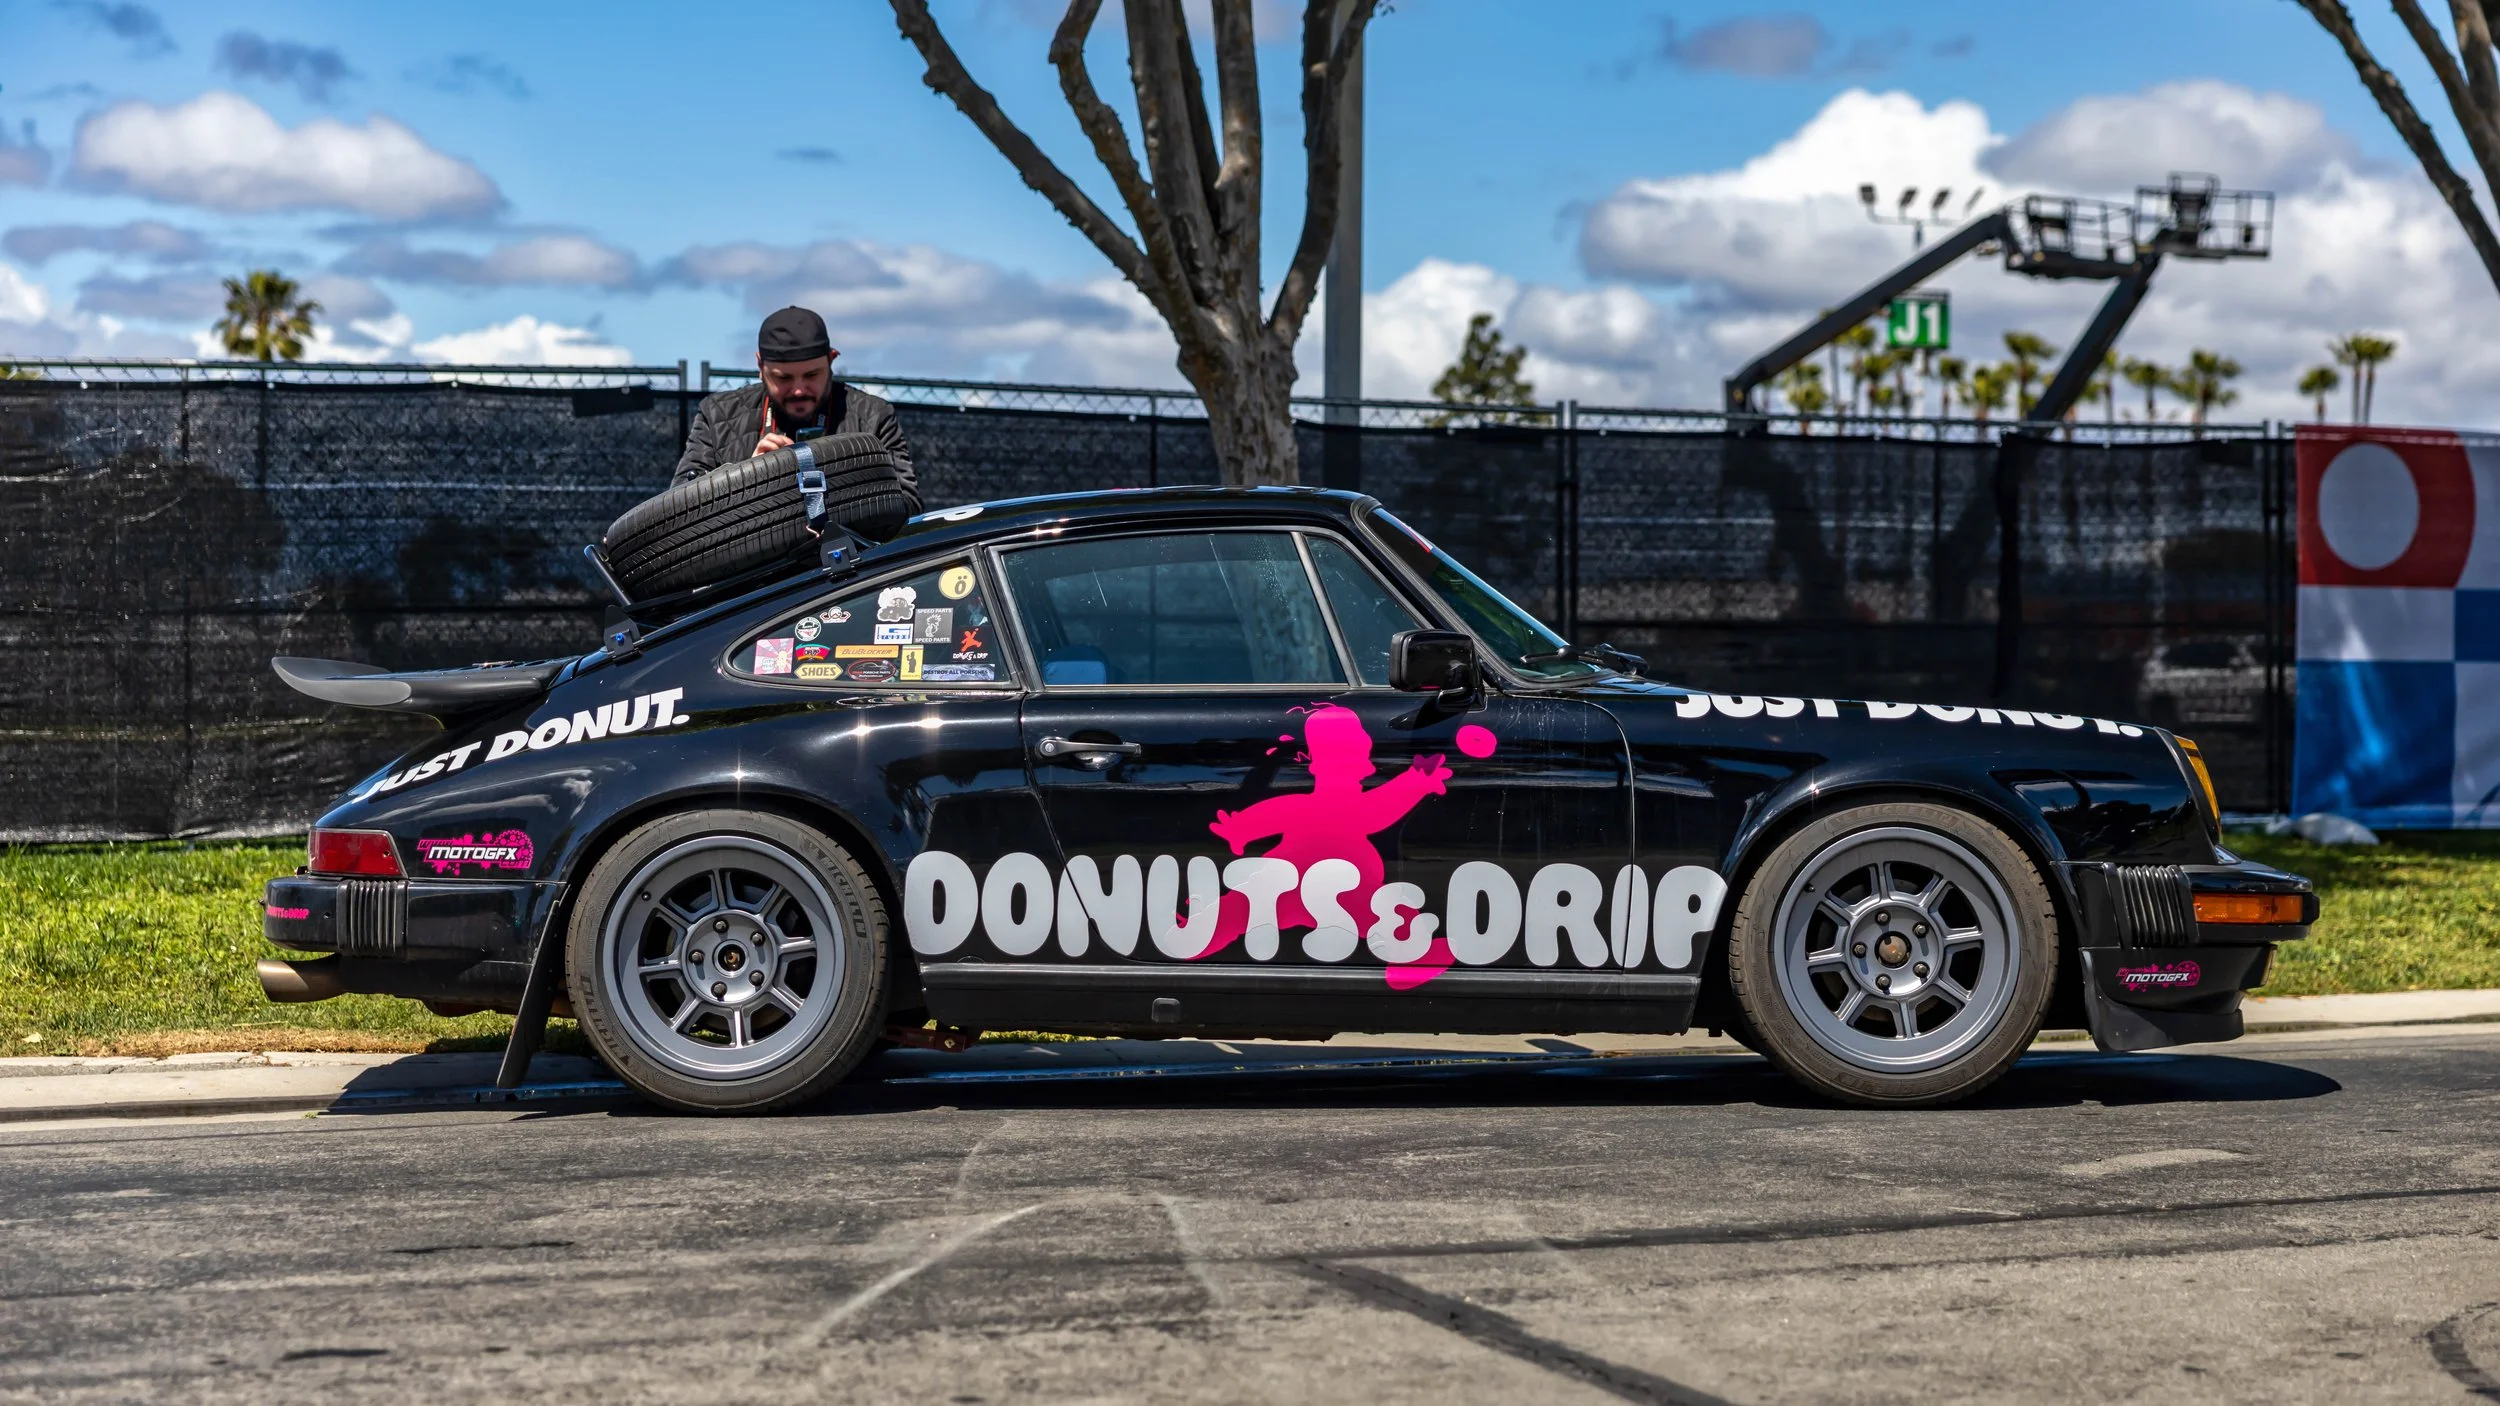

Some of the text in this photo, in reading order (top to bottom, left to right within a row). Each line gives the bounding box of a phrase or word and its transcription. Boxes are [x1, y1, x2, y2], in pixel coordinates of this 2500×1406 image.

[1893, 301, 1940, 344] J1
[801, 666, 837, 677] SHOES
[350, 687, 690, 804] JUST DONUT.
[428, 846, 517, 860] MOTOGFX
[2125, 972, 2190, 983] MOTOGFX
